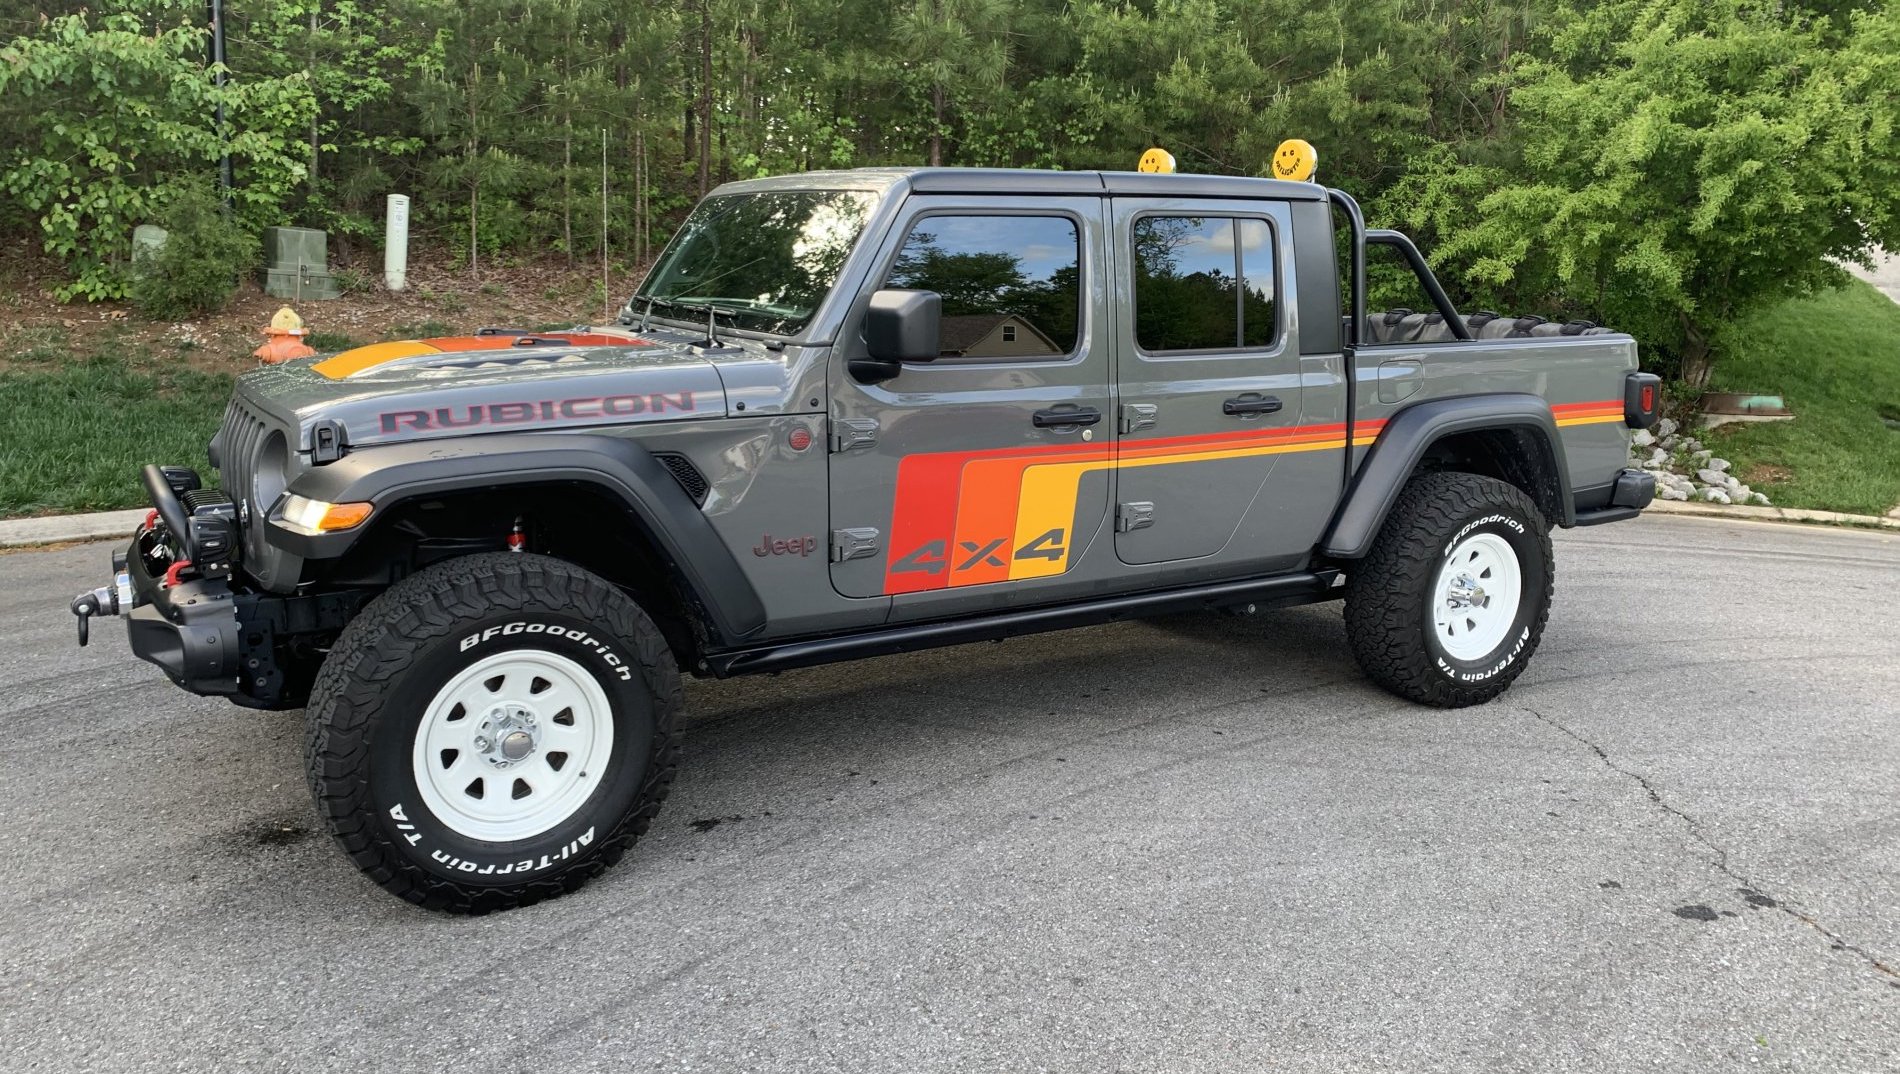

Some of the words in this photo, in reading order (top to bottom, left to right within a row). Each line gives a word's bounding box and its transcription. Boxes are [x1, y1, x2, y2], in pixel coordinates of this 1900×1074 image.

[379, 390, 696, 434] RUBICON
[752, 532, 818, 558] Jeep
[1444, 514, 1525, 557] BFGoodrich
[459, 621, 632, 682] BFGoodrich
[1437, 656, 1456, 679] T/A
[1461, 625, 1530, 683] All-Terrain
[388, 803, 423, 847] T/A
[431, 825, 596, 875] All-Terrain
